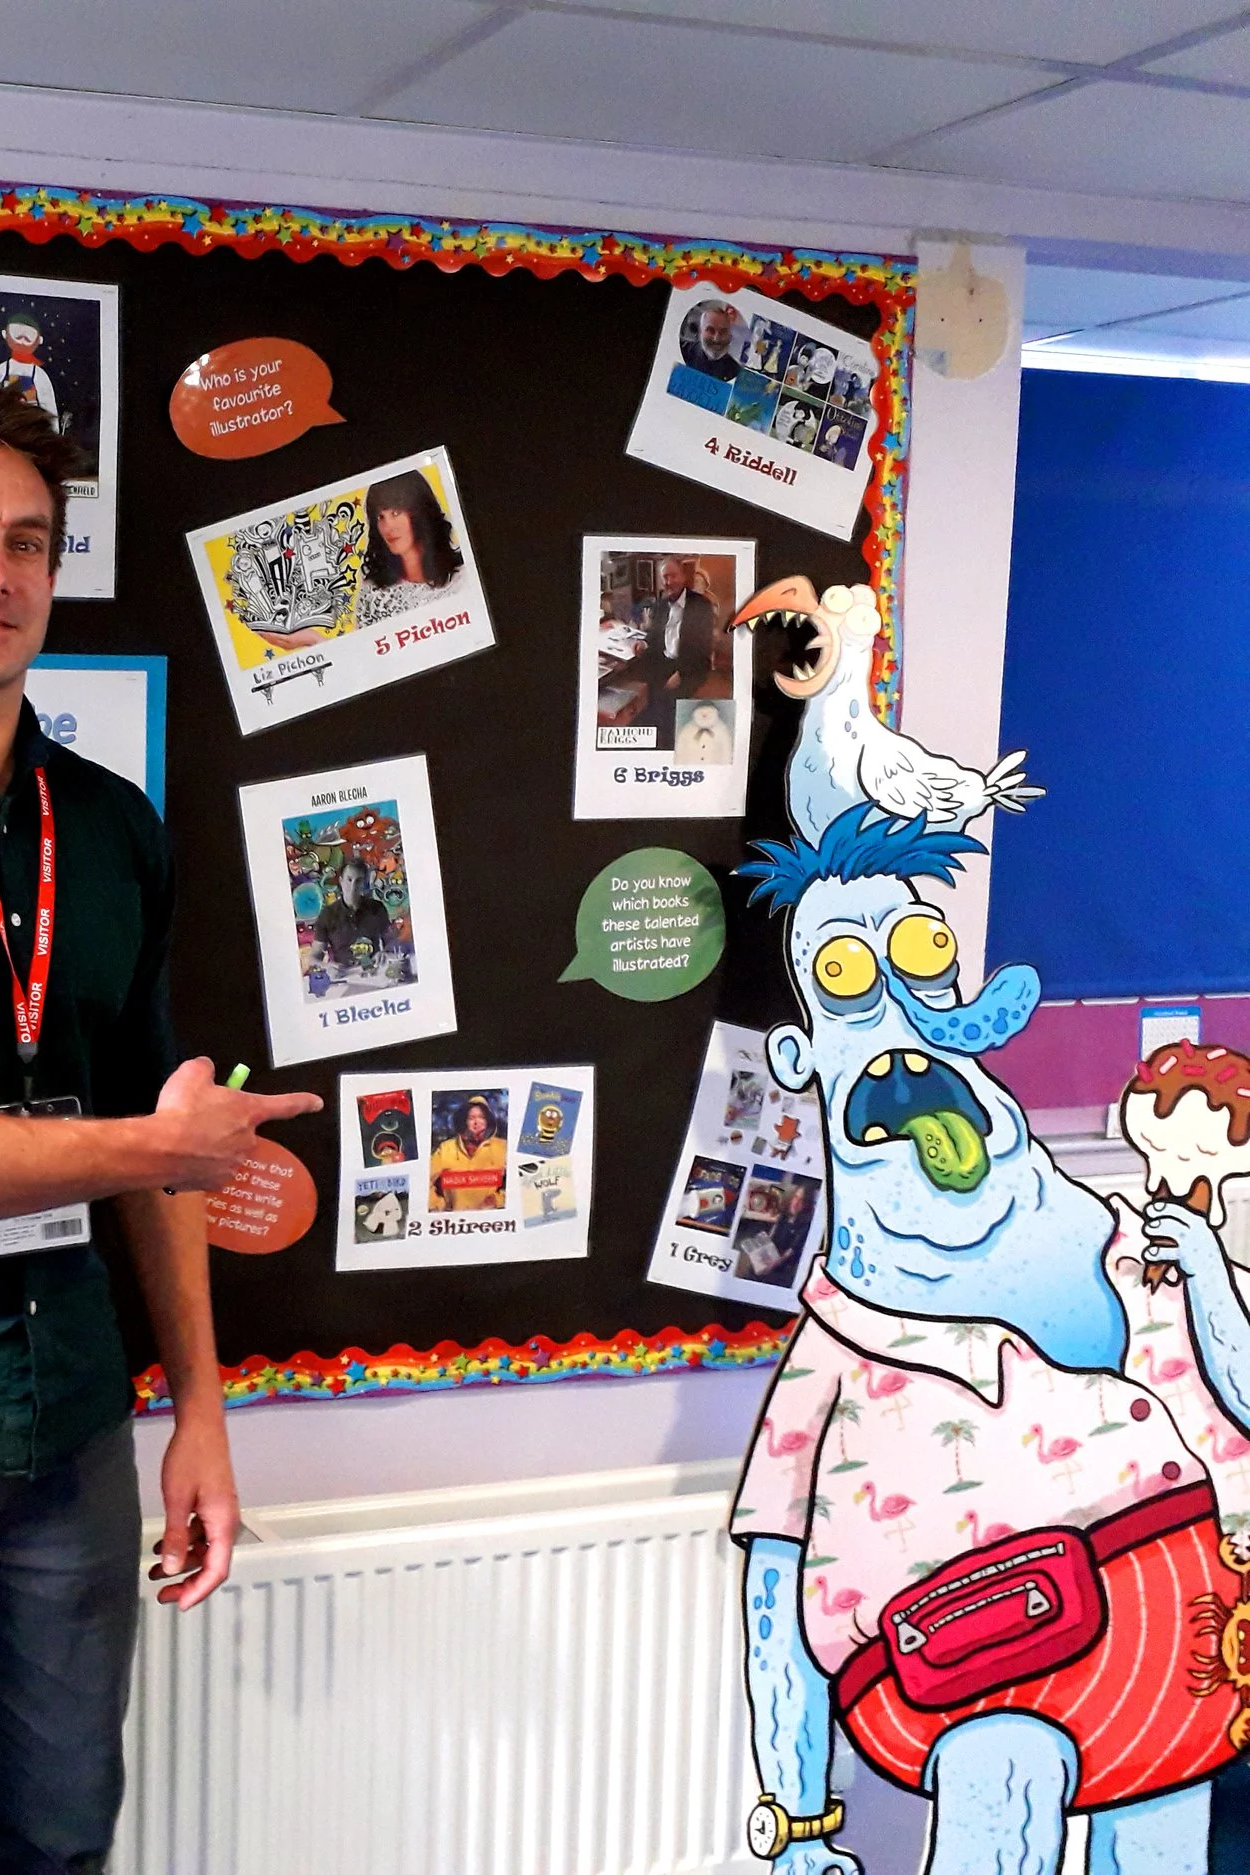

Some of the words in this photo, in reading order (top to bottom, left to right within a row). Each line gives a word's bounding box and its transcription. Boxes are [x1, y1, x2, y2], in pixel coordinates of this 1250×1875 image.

[200, 373, 231, 392] Who
[233, 367, 247, 383] is
[250, 359, 283, 382] your
[213, 383, 281, 412] favourite
[210, 400, 293, 437] illustrator?
[704, 437, 720, 456] 4
[724, 442, 798, 486] Riddell
[373, 635, 392, 656] 5
[394, 611, 472, 649] Pichon
[253, 667, 273, 684] Liz
[613, 767, 628, 783] 6
[633, 766, 705, 787] Briggs
[37, 774, 50, 817] VISITOR
[311, 791, 337, 807] AARON
[338, 786, 367, 802] BLECHA
[42, 837, 53, 883] VISITOR
[611, 877, 629, 891] Do
[632, 878, 655, 893] you
[658, 875, 691, 888] know
[612, 896, 649, 911] which
[652, 894, 689, 909] books
[37, 908, 51, 956] VISITOR
[601, 918, 640, 932] these
[644, 913, 699, 930] talented
[610, 936, 658, 952] artists
[660, 935, 691, 948] have
[613, 953, 690, 972] illustrated?
[16, 1002, 31, 1043] VISITO
[318, 1011, 329, 1028] 1
[334, 998, 412, 1025] Blecha
[242, 1159, 268, 1171] now
[269, 1163, 295, 1178] that
[235, 1172, 250, 1182] of
[251, 1174, 281, 1191] these
[357, 1180, 379, 1192] YETI
[534, 1175, 561, 1189] WOLF
[222, 1186, 253, 1200] ators
[254, 1194, 284, 1208] write
[206, 1196, 228, 1210] ries
[229, 1204, 243, 1214] as
[244, 1207, 265, 1219] well
[265, 1212, 278, 1223] as
[218, 1216, 270, 1236] pictures?
[408, 1219, 423, 1237] 2
[427, 1218, 517, 1237] Shireen
[682, 1245, 734, 1273] Grey
